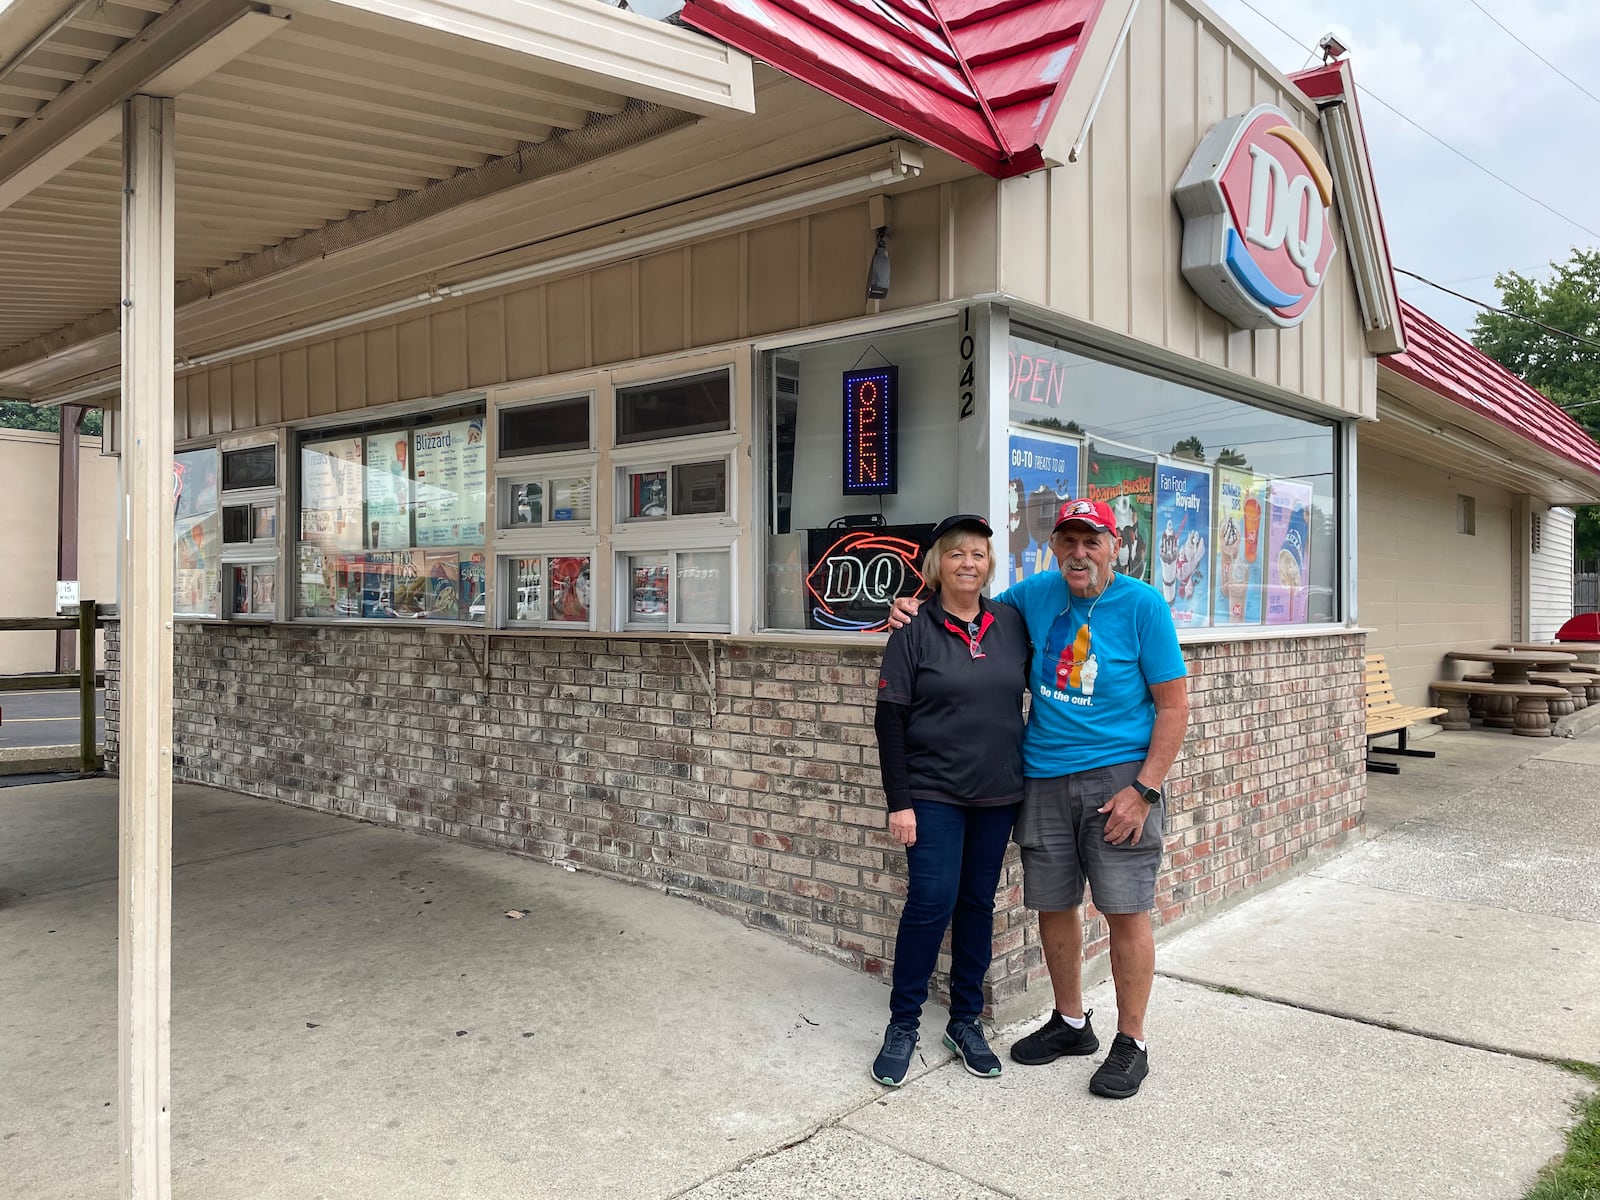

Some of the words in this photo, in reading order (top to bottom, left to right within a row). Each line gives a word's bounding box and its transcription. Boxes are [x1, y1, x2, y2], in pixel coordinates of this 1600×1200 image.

[1246, 143, 1323, 287] DQ
[960, 306, 974, 419] 1042
[416, 430, 451, 451] Blizzard
[860, 381, 877, 483] OPEN
[1011, 448, 1033, 468] GO-TO
[1034, 455, 1051, 471] TREATS
[1052, 458, 1058, 472] TO
[1058, 459, 1065, 473] GO
[1122, 476, 1152, 496] Buster
[1160, 474, 1171, 490] Fan
[1172, 476, 1187, 492] Food
[1175, 492, 1201, 512] Royalty
[64, 585, 72, 593] 15
[824, 553, 905, 607] DQ
[1041, 685, 1052, 697] Do
[1054, 691, 1070, 702] the
[1071, 696, 1094, 707] curl.
